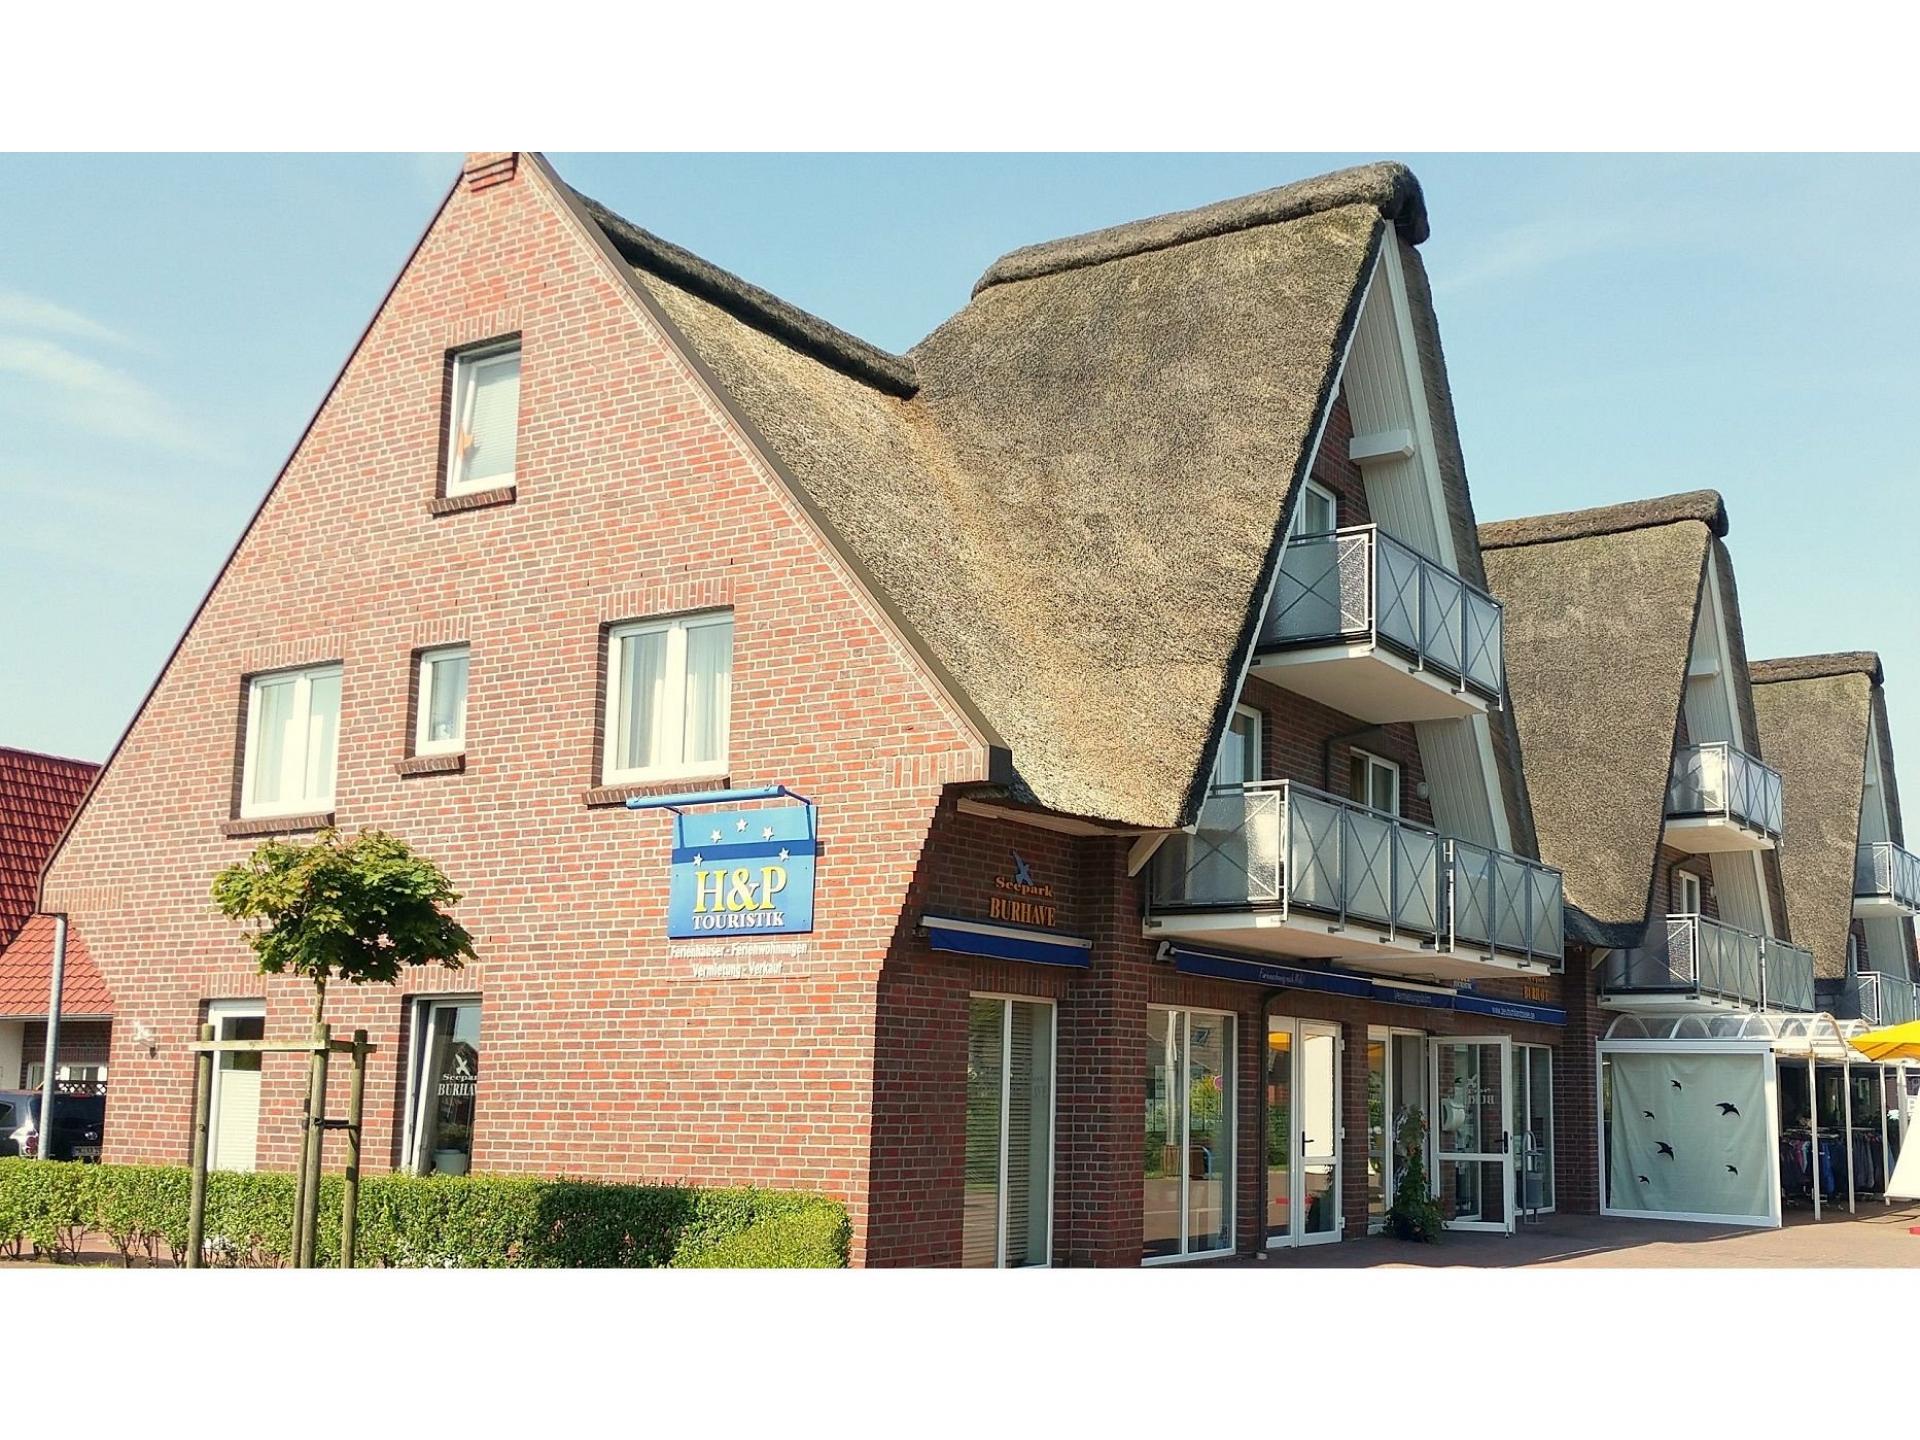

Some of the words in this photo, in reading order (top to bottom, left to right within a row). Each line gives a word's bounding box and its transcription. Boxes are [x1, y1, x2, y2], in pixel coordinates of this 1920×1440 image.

[694, 867, 787, 912] H&P
[995, 876, 1054, 897] Seepark
[692, 912, 785, 929] TOURISTIK
[990, 897, 1056, 926] BURHAVE
[443, 1073, 477, 1081] Seepar
[438, 1083, 477, 1096] BURHA
